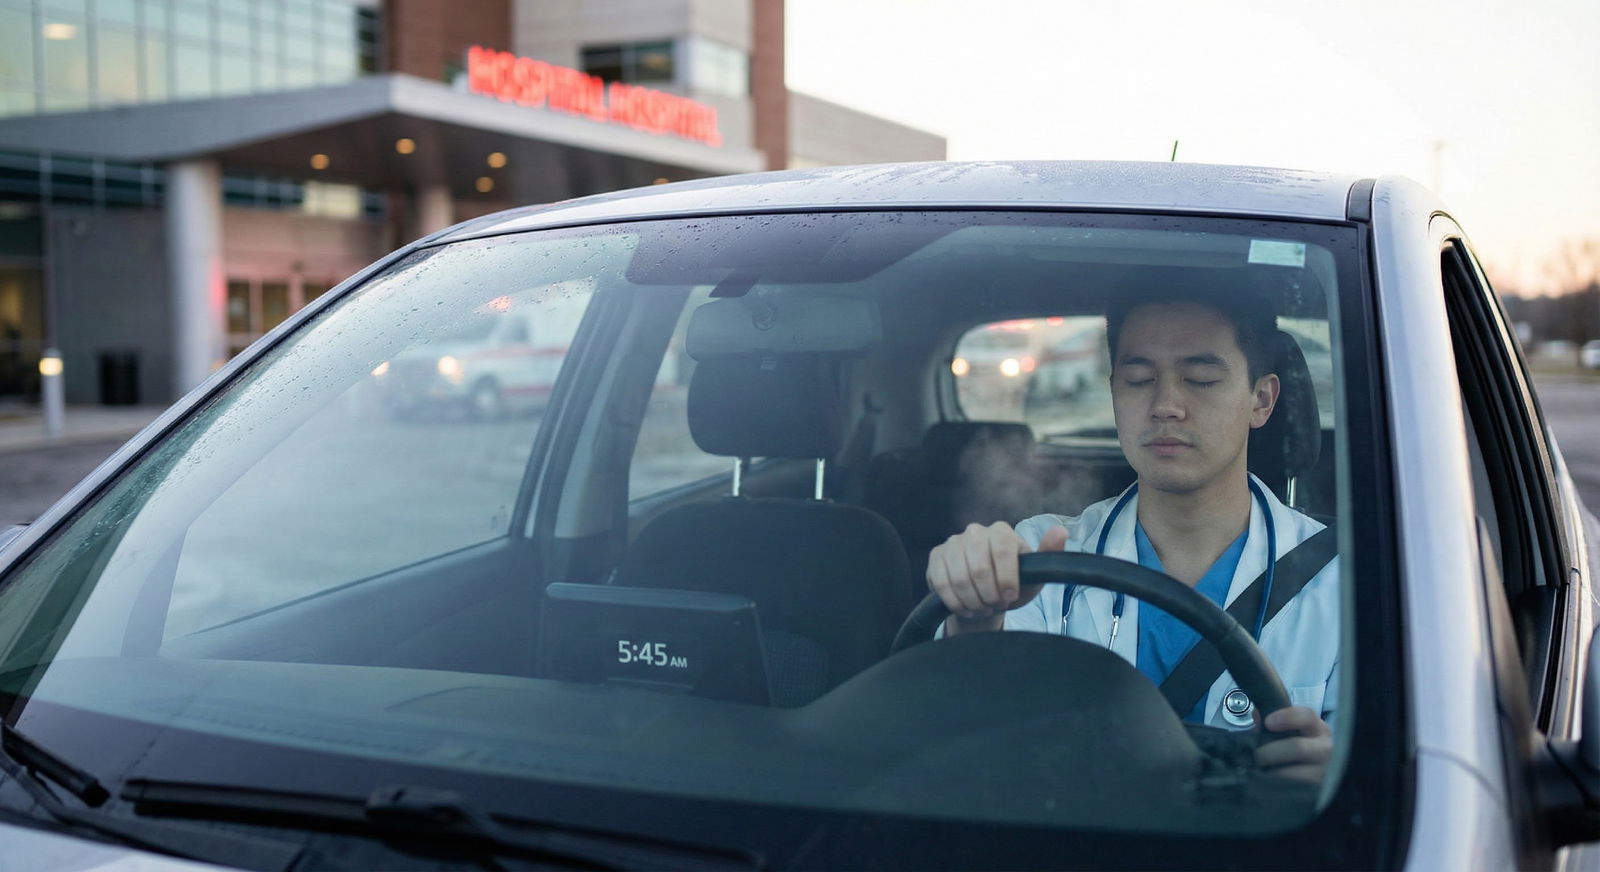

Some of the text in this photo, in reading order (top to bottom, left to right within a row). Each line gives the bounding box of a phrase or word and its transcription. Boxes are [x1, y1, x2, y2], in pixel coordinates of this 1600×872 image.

[467, 45, 608, 122] HOSPITAL
[618, 640, 688, 668] 5:45 AM
